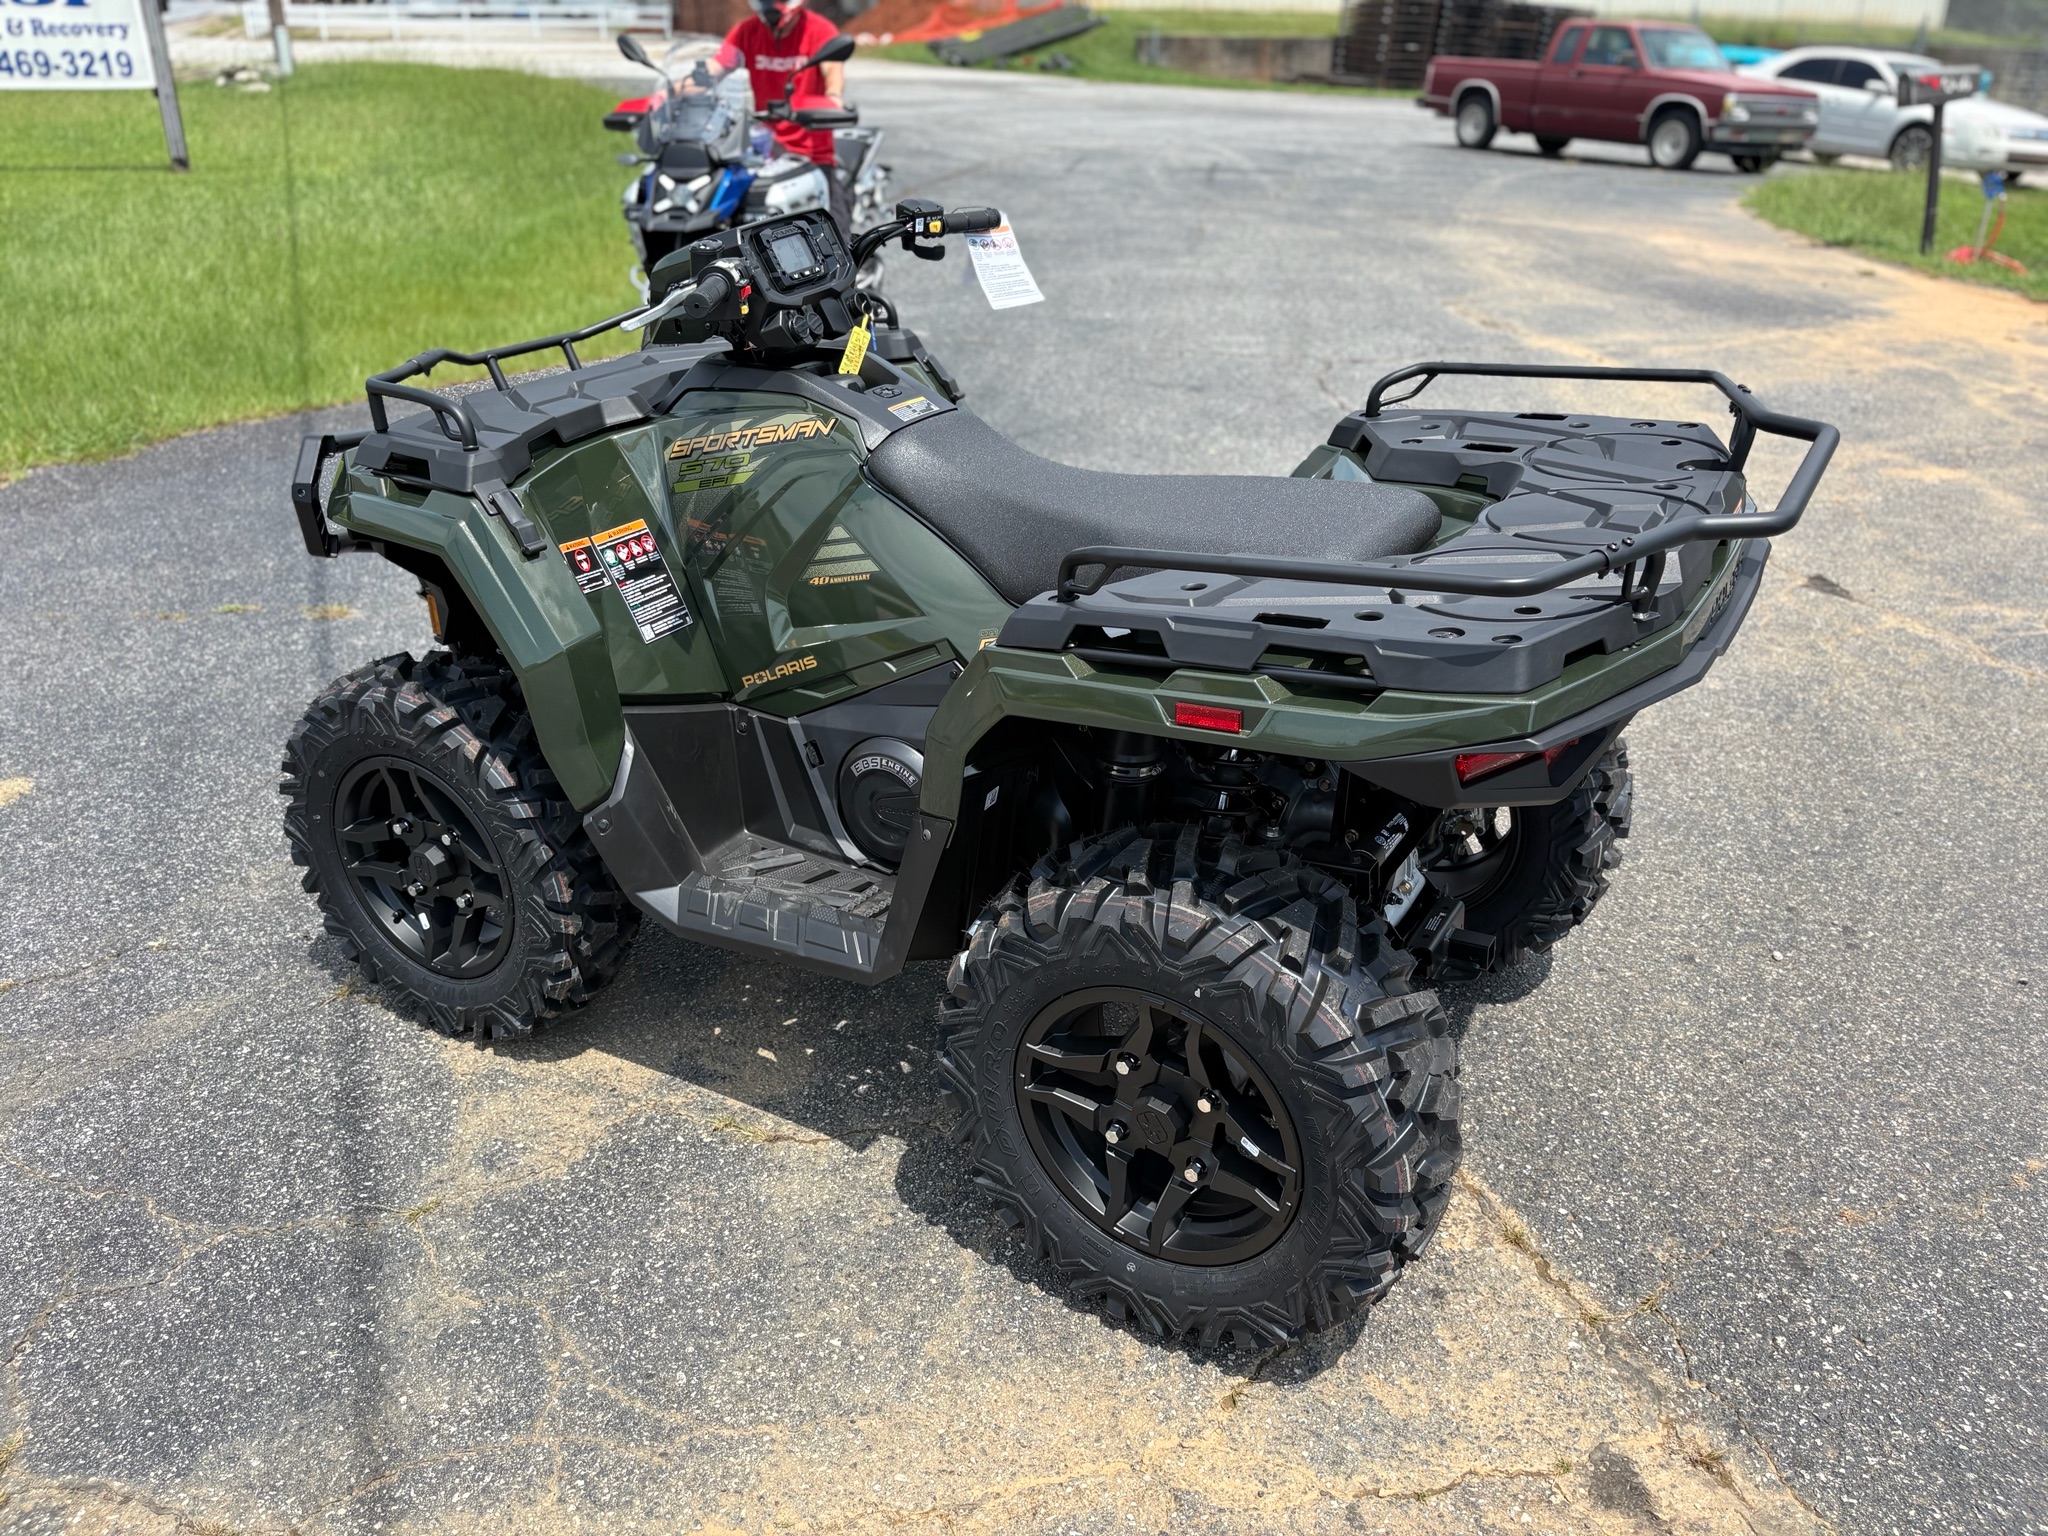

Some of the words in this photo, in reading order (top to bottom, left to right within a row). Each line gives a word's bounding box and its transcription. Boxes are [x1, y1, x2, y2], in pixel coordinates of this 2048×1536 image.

[30, 18, 129, 40] Recovery
[0, 51, 133, 77] 469-3219
[669, 417, 839, 460] SPORTSMAN
[679, 453, 751, 476] 570
[698, 476, 730, 489] EFI
[809, 576, 830, 586] 40
[830, 573, 871, 584] ANNIVERSARY
[741, 655, 818, 689] POLARIS
[854, 758, 879, 774] EBS
[881, 759, 916, 784] ENGINE
